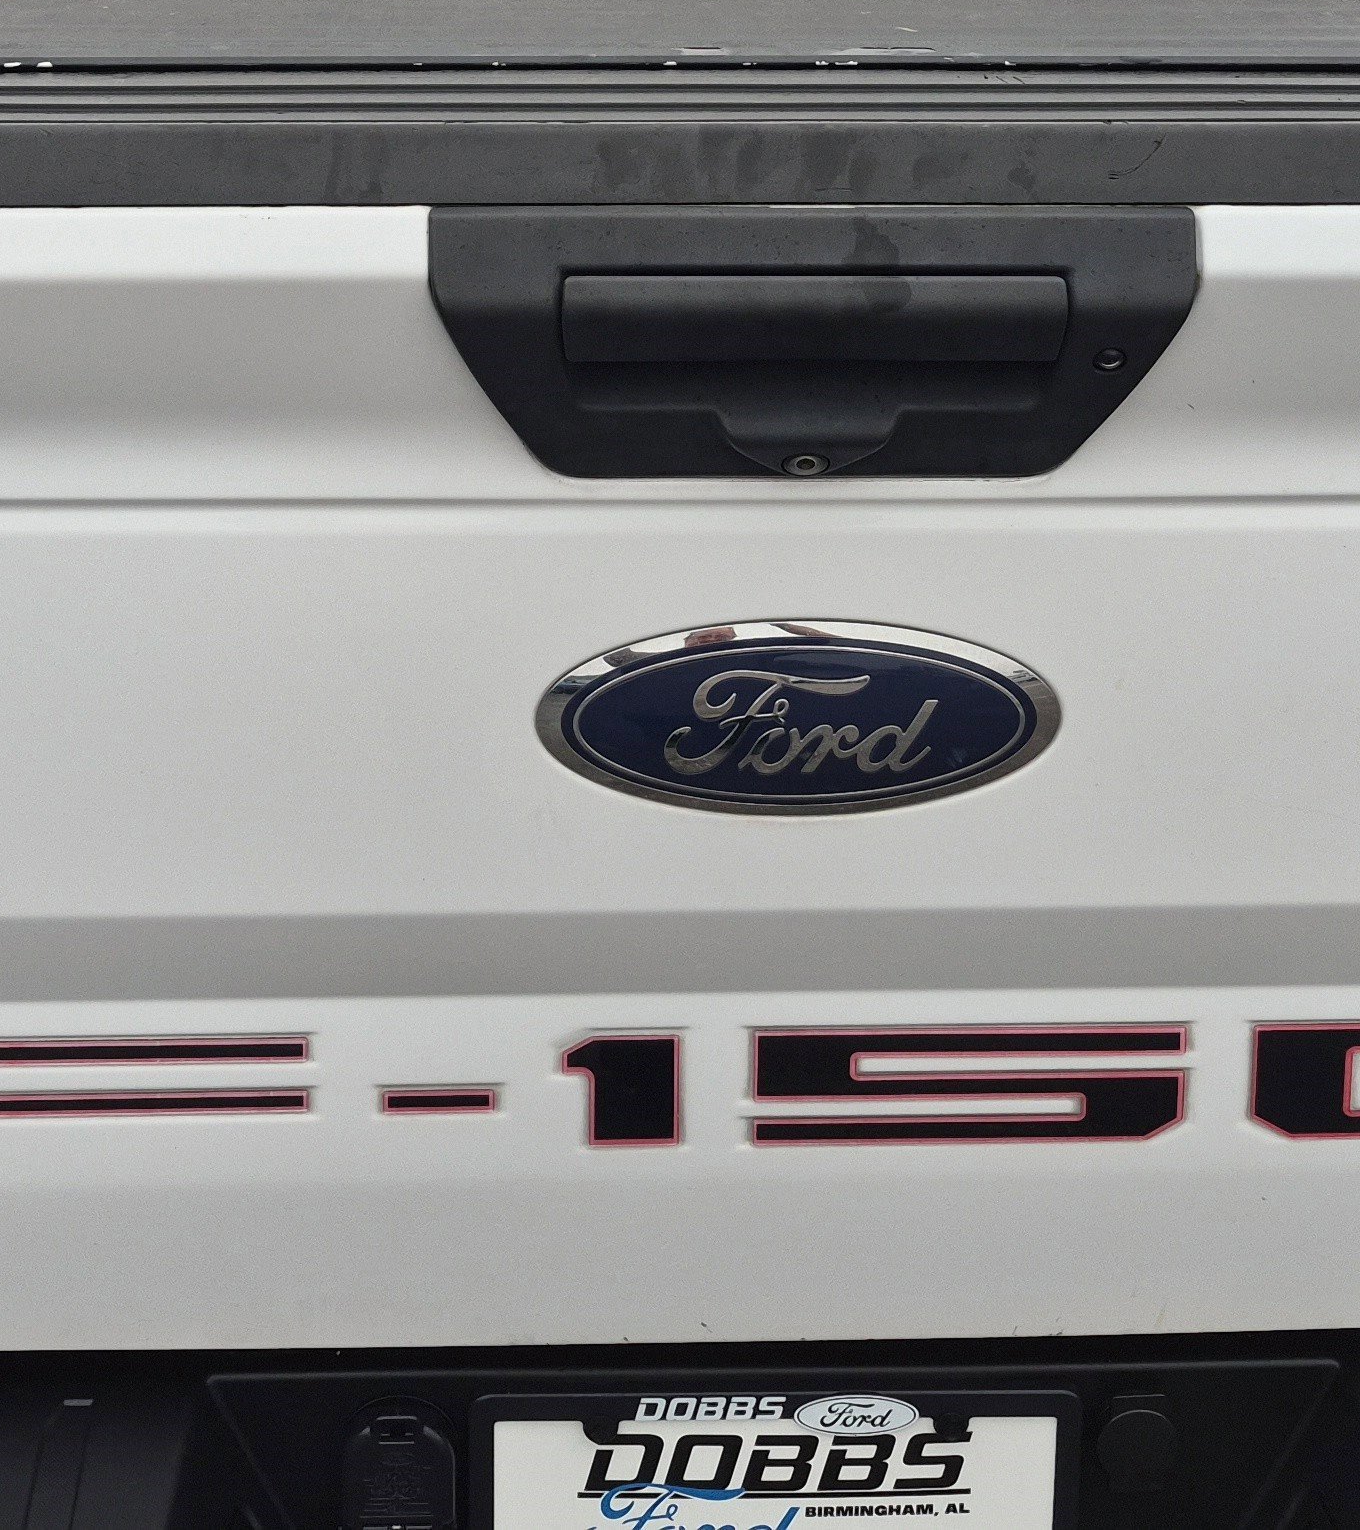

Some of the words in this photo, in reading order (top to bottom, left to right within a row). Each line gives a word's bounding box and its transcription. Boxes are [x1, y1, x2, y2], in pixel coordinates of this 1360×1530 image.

[663, 670, 940, 776] Ford
[634, 1396, 786, 1422] DOBBS
[819, 1403, 892, 1428] Ford
[583, 1430, 974, 1492] DOBBS
[804, 1503, 939, 1518] BIRMINGHAM,
[943, 1502, 971, 1515] AL
